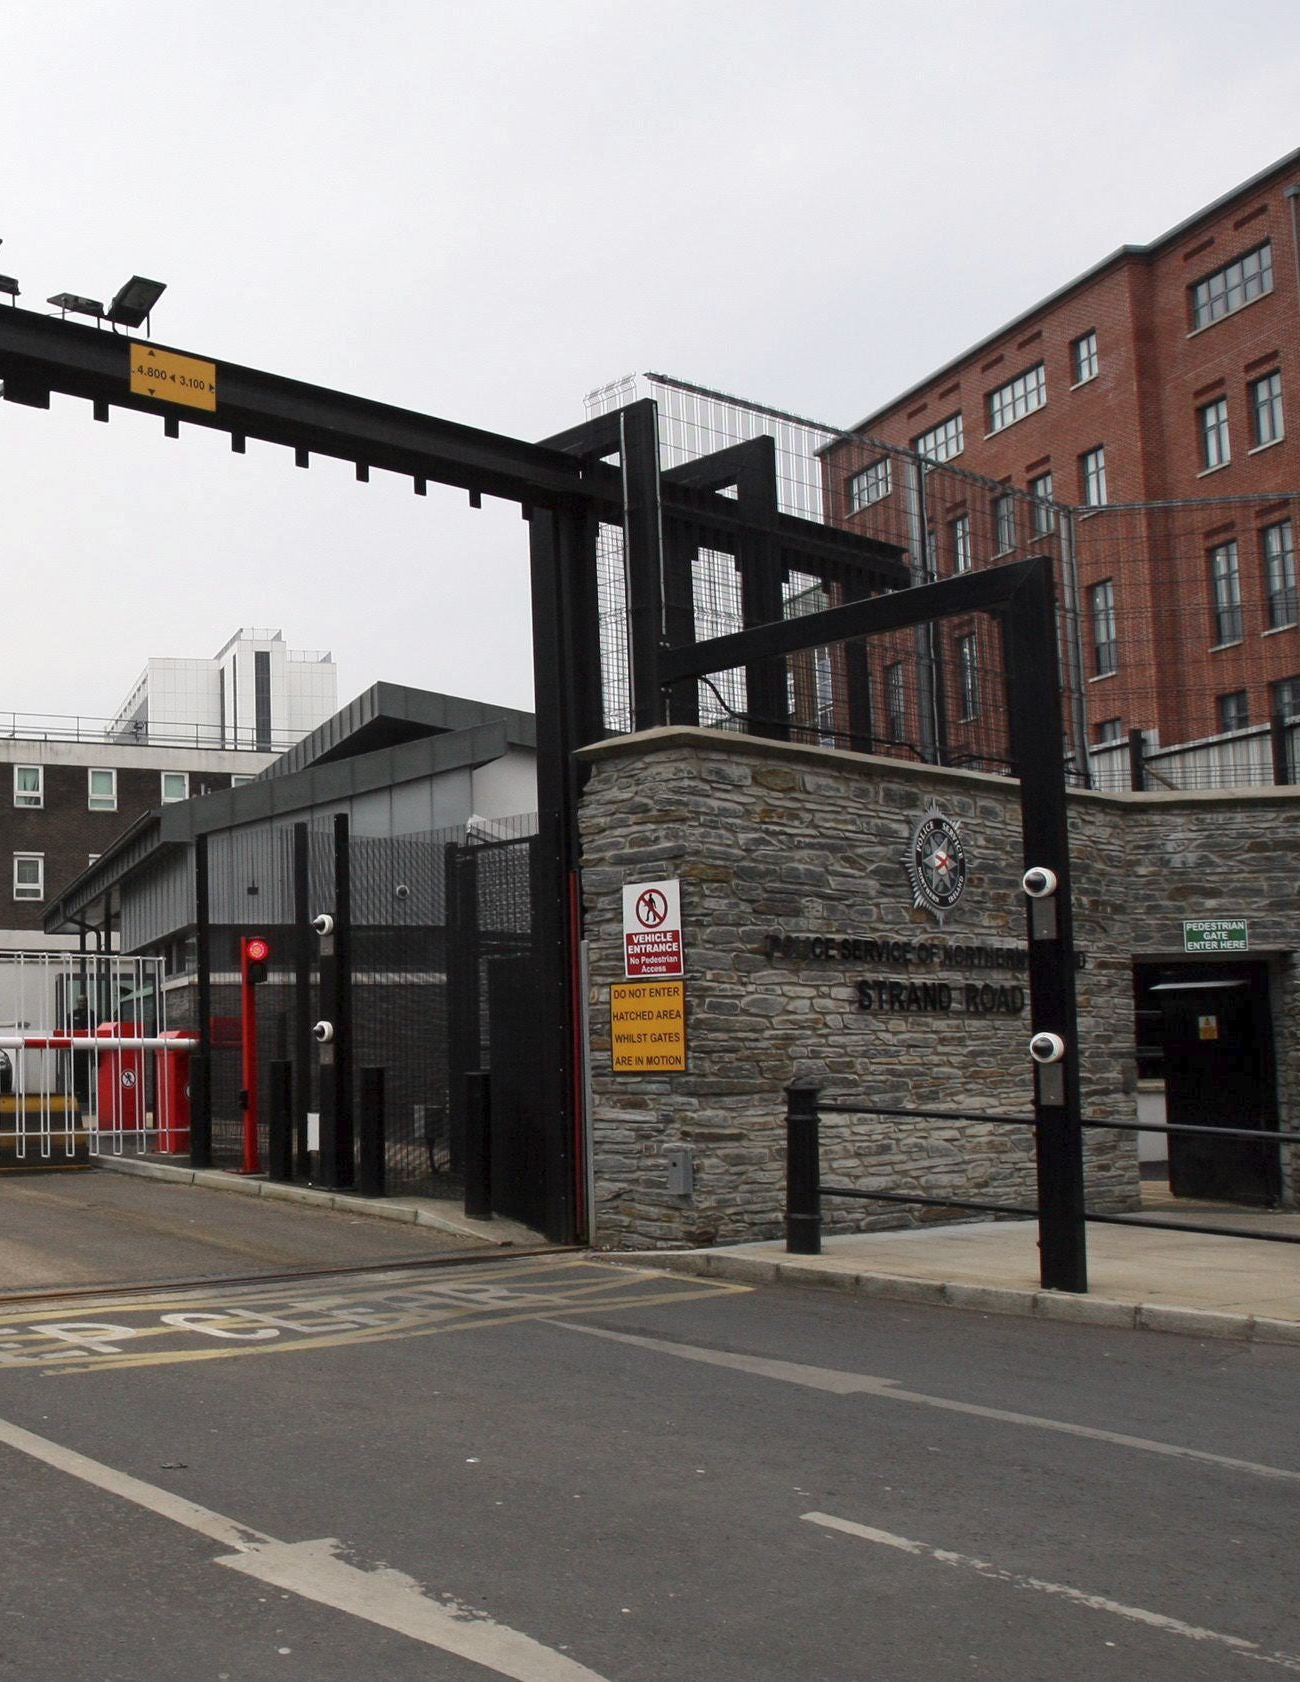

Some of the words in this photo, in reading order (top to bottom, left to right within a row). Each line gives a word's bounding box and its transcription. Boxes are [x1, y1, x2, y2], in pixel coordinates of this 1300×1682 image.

[138, 365, 167, 381] 4.800
[180, 375, 205, 391] 3.100
[916, 820, 935, 852] POLICE
[941, 822, 964, 860] SERVICE
[1186, 921, 1245, 931] PEDESTRIAN
[632, 932, 673, 944] VEHICLE
[1203, 931, 1229, 940] GATE
[628, 942, 679, 954] ENTRANCE
[840, 937, 913, 963] SERVICE
[916, 942, 941, 964] OF
[1187, 941, 1218, 950] ENTER
[1220, 940, 1246, 949] HERE
[630, 956, 640, 965] No
[641, 955, 678, 965] Pedestrian
[641, 965, 667, 973] Access
[613, 989, 627, 1000] DO
[628, 988, 647, 998] NOT
[649, 986, 680, 998] ENTER
[857, 979, 952, 1012] STRAND
[965, 982, 1025, 1014] ROAD
[612, 1010, 654, 1021] HATCHED
[656, 1009, 682, 1020] AREA
[614, 1033, 648, 1043] WHILST
[650, 1032, 681, 1043] GATES
[615, 1056, 633, 1066] ARE
[635, 1056, 644, 1066] IN
[646, 1055, 682, 1066] MOTION
